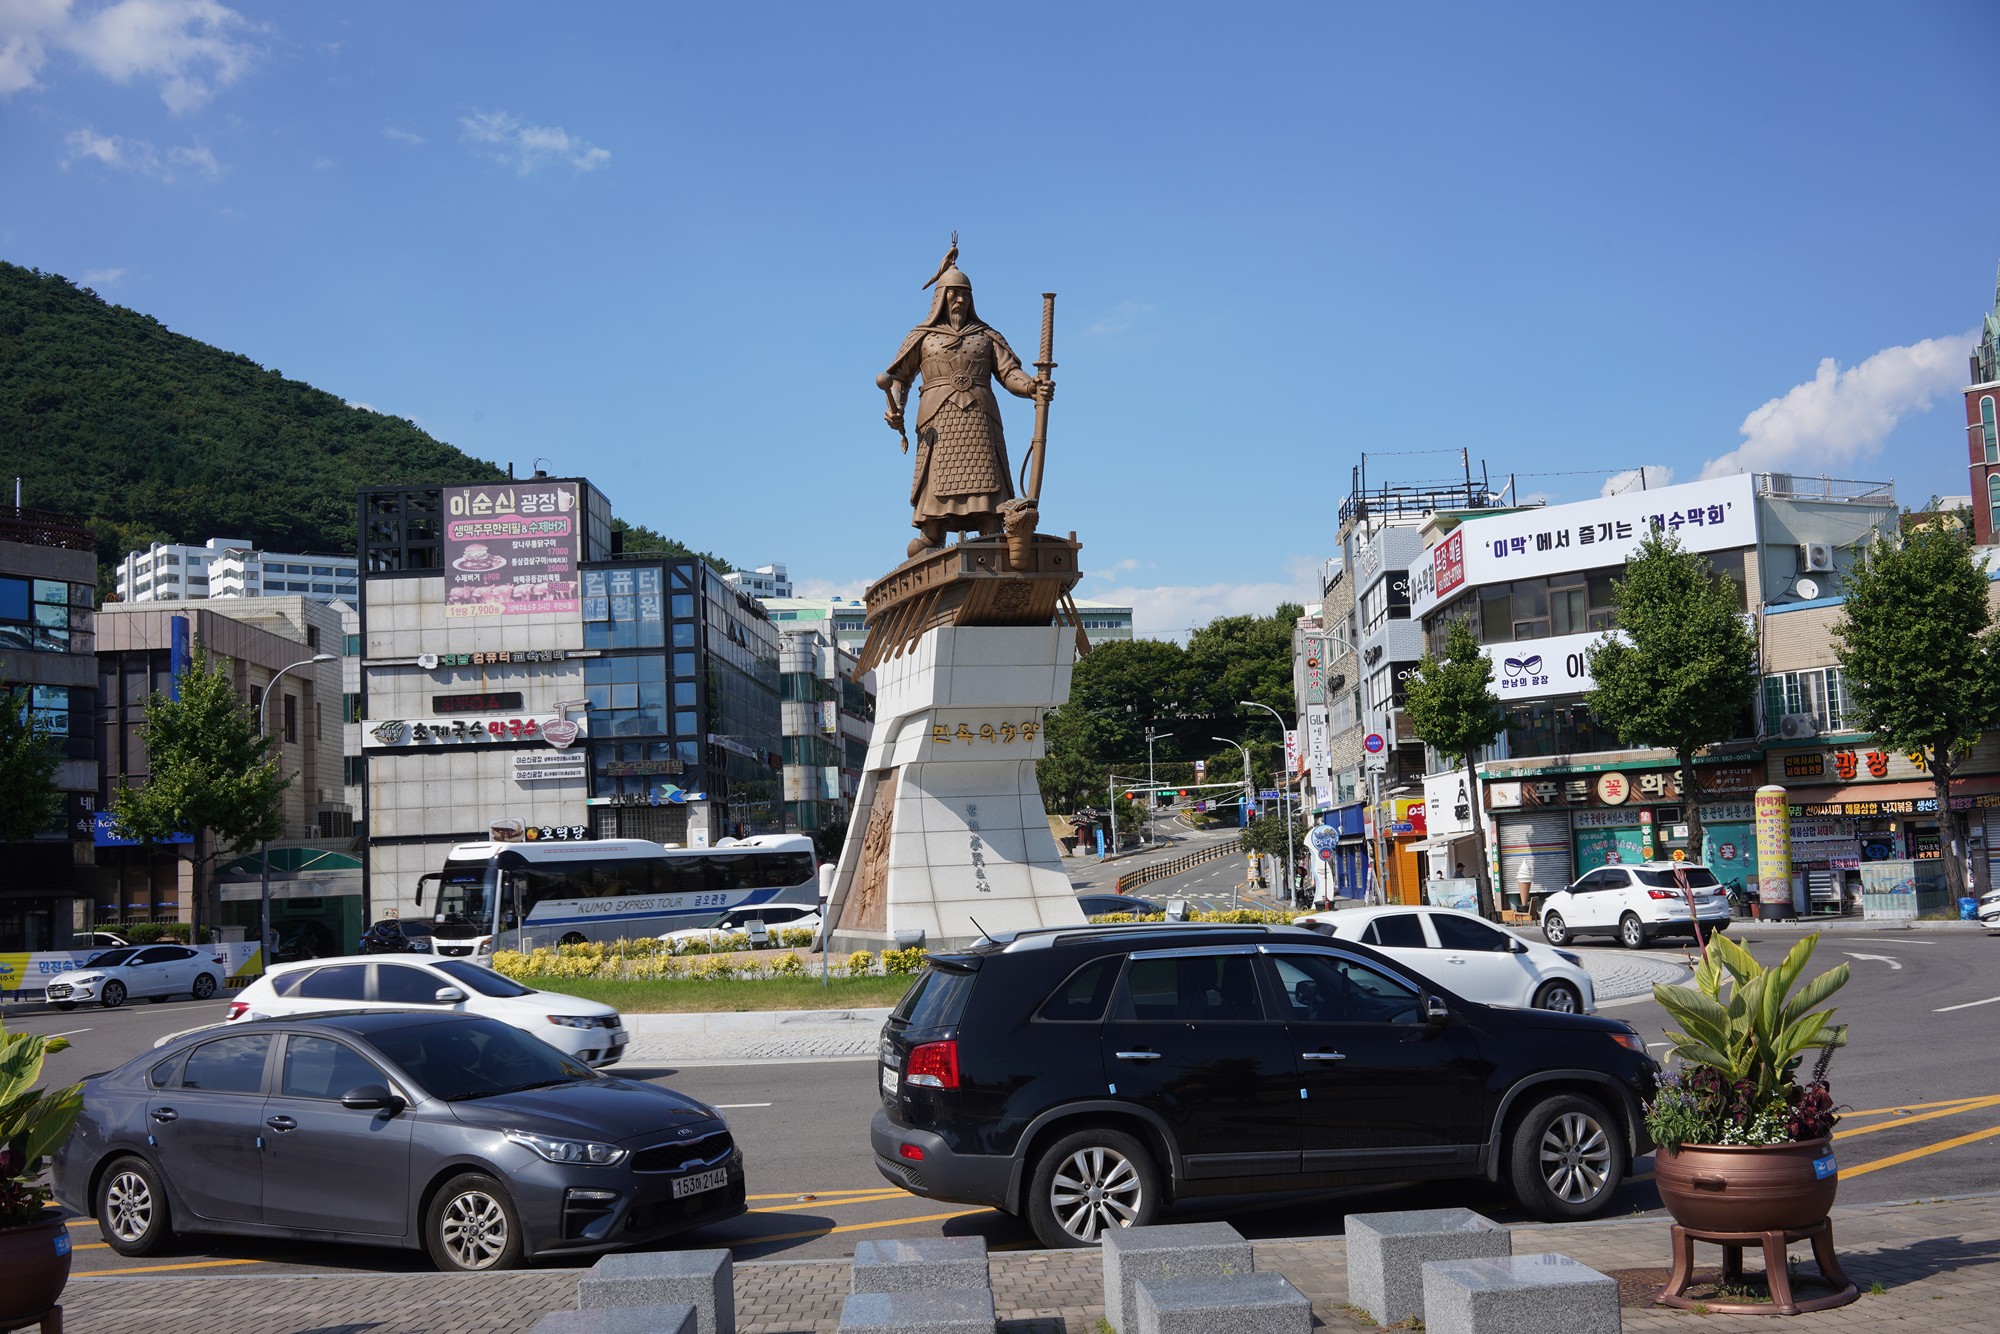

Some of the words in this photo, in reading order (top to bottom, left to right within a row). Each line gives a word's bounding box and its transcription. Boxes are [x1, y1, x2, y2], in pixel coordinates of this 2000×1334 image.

[450, 488, 516, 516] 이순신
[521, 493, 556, 513] 광장
[1579, 520, 1633, 546] 즐기는
[455, 573, 480, 582] 수제버거
[548, 564, 568, 572] 25000
[585, 569, 660, 597] 컴퓨터
[444, 653, 470, 666] 진남
[473, 651, 511, 664] 컴퓨터
[513, 648, 566, 662] 교육센터
[1501, 677, 1528, 689] 만남의
[1531, 675, 1549, 686] 광장
[413, 720, 485, 742] 초계국수
[488, 718, 539, 739] 막국수
[1785, 754, 1822, 765] 선어사시미
[1834, 751, 1888, 778] 광장
[1535, 780, 1589, 803] 푸른
[1605, 779, 1622, 797] 꽃
[1806, 803, 1843, 816] 선어사시미
[1845, 802, 1878, 815] 해물삼합
[1881, 800, 1913, 813] 낙지볶음
[577, 901, 613, 914] KUMO
[615, 898, 654, 912] EXPRESS
[656, 897, 684, 909] TOUR
[694, 893, 727, 907] 금오관광
